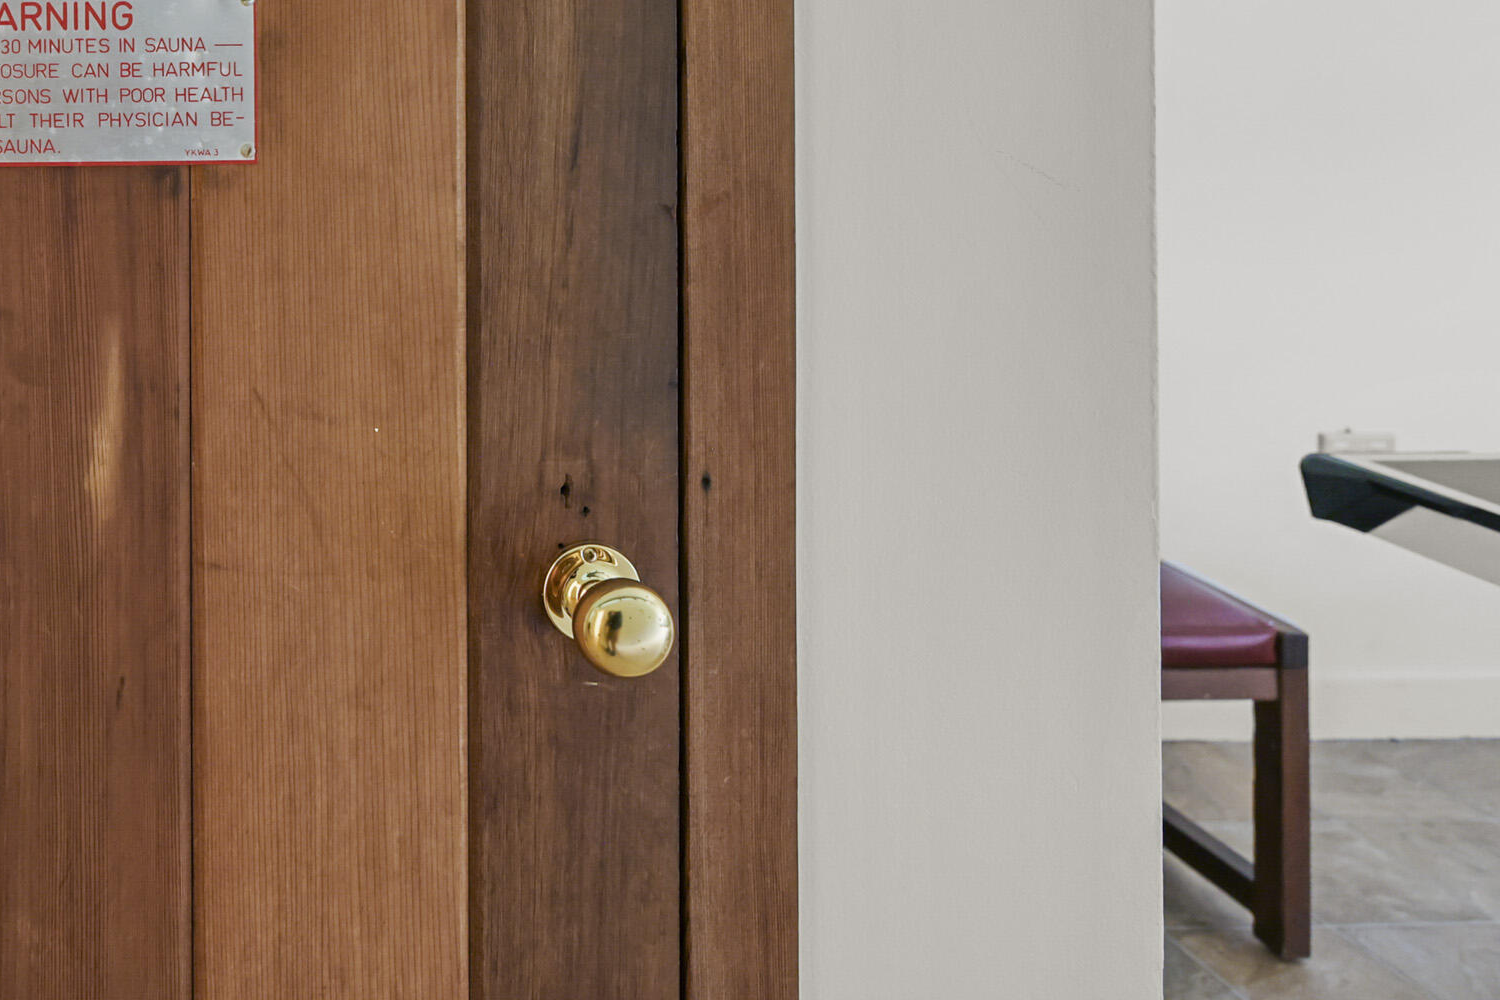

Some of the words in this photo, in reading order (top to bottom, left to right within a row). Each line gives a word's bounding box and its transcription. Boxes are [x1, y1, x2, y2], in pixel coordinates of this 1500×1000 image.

[0, 38, 21, 56] 30
[27, 37, 111, 55] MINUTES
[118, 37, 136, 54] IN
[144, 36, 206, 54] SAUNA
[71, 62, 110, 79] CAN
[119, 61, 143, 79] BE
[152, 60, 244, 78] HARMFUL
[62, 87, 109, 104] WITH
[119, 86, 166, 104] POOR
[174, 85, 244, 103] HEALTH
[29, 112, 85, 129] THEIR
[97, 111, 199, 129] PHYSICIAN
[210, 110, 246, 128] BE-
